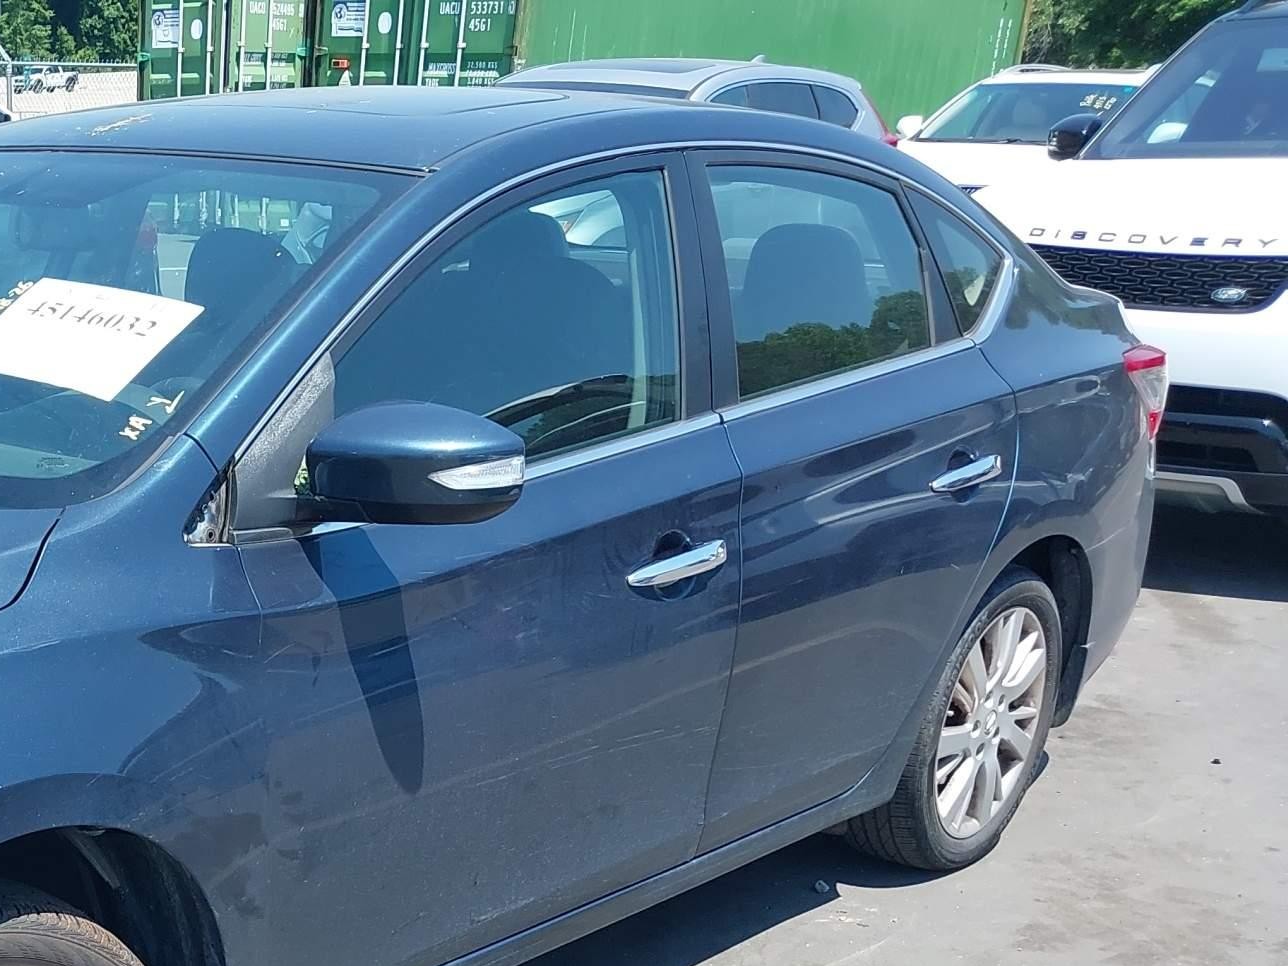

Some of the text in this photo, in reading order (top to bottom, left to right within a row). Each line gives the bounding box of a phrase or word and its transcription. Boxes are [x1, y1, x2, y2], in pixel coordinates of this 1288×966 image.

[440, 2, 461, 15] UACU
[470, 1, 504, 14] 533731
[469, 18, 491, 31] 45G1
[1029, 227, 1279, 248] DISCOVERY
